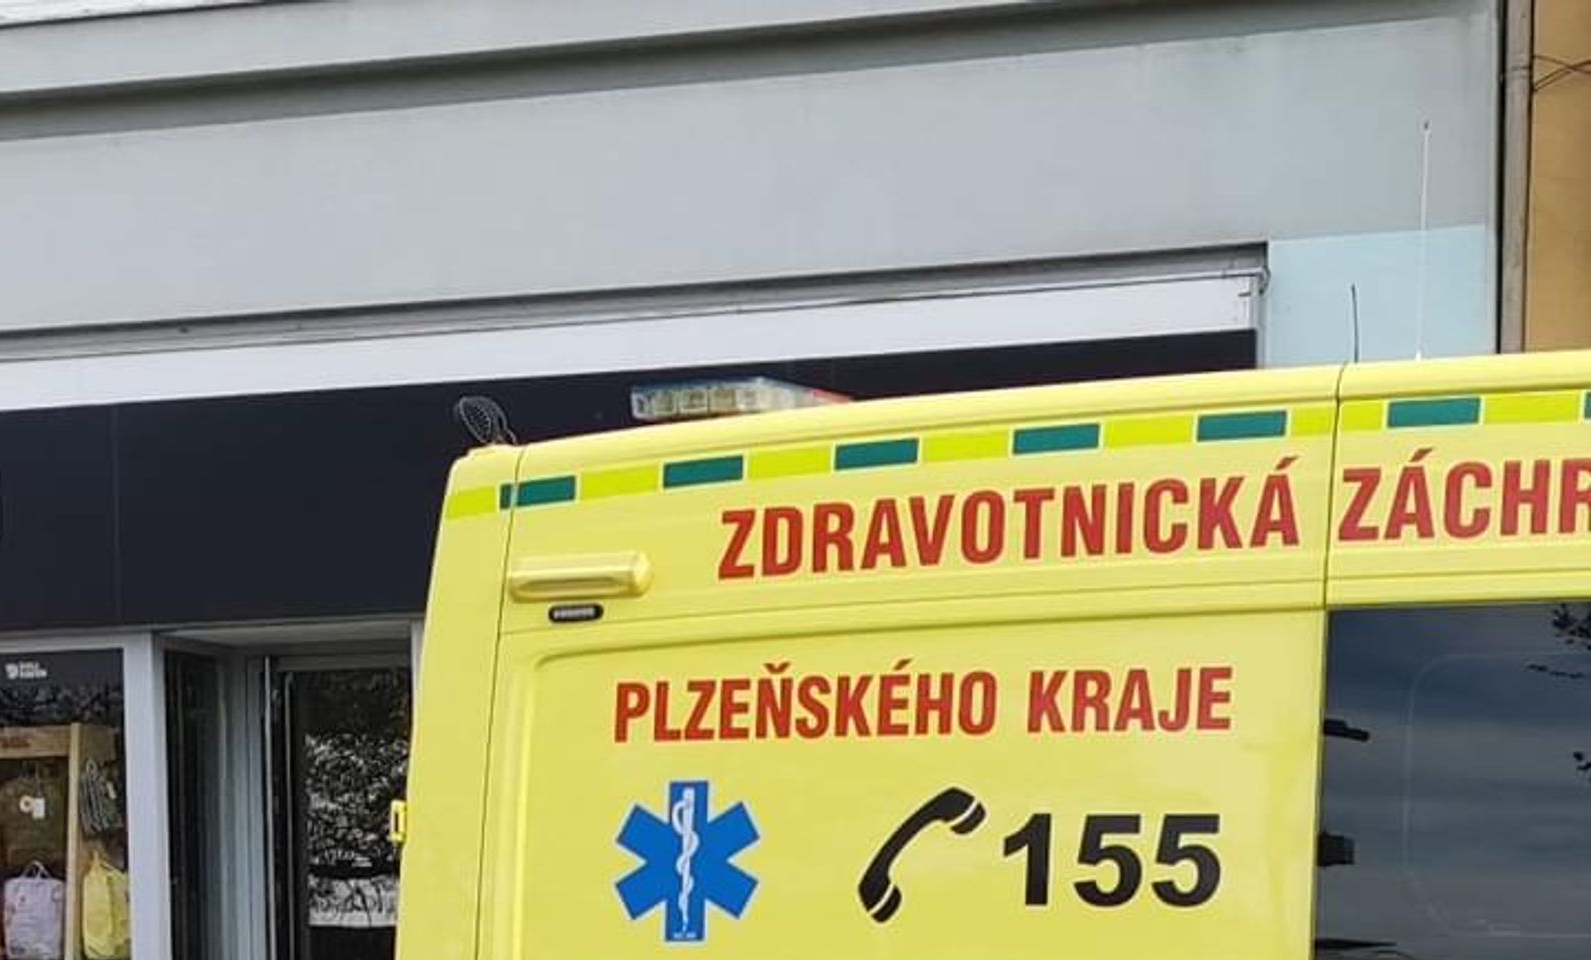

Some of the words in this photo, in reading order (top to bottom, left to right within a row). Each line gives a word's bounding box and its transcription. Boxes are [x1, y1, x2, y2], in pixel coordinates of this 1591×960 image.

[717, 455, 1301, 580] ZDRAVOTNICKÁ
[1337, 447, 1591, 542] ZÁCHR
[613, 659, 998, 744] PLZEŇSKÉHO
[1025, 666, 1235, 734] KRAJE
[1001, 810, 1224, 909] 155
